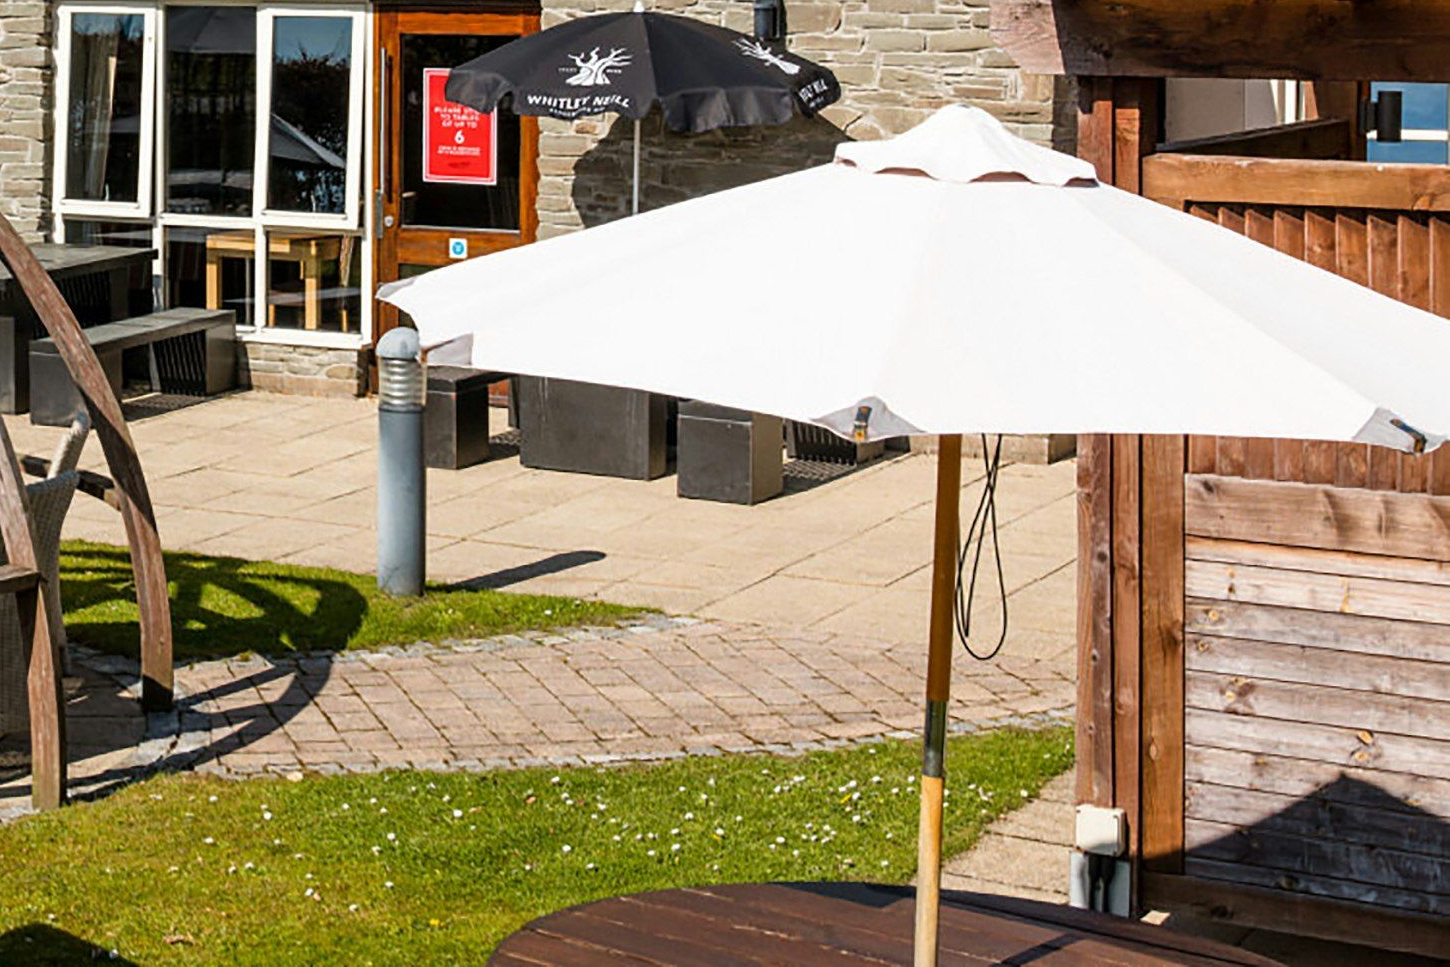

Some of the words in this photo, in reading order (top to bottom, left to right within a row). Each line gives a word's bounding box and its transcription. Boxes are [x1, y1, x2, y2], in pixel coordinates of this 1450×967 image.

[526, 94, 591, 110] WHITLEY
[592, 94, 630, 108] NEILL
[454, 130, 465, 144] 6
